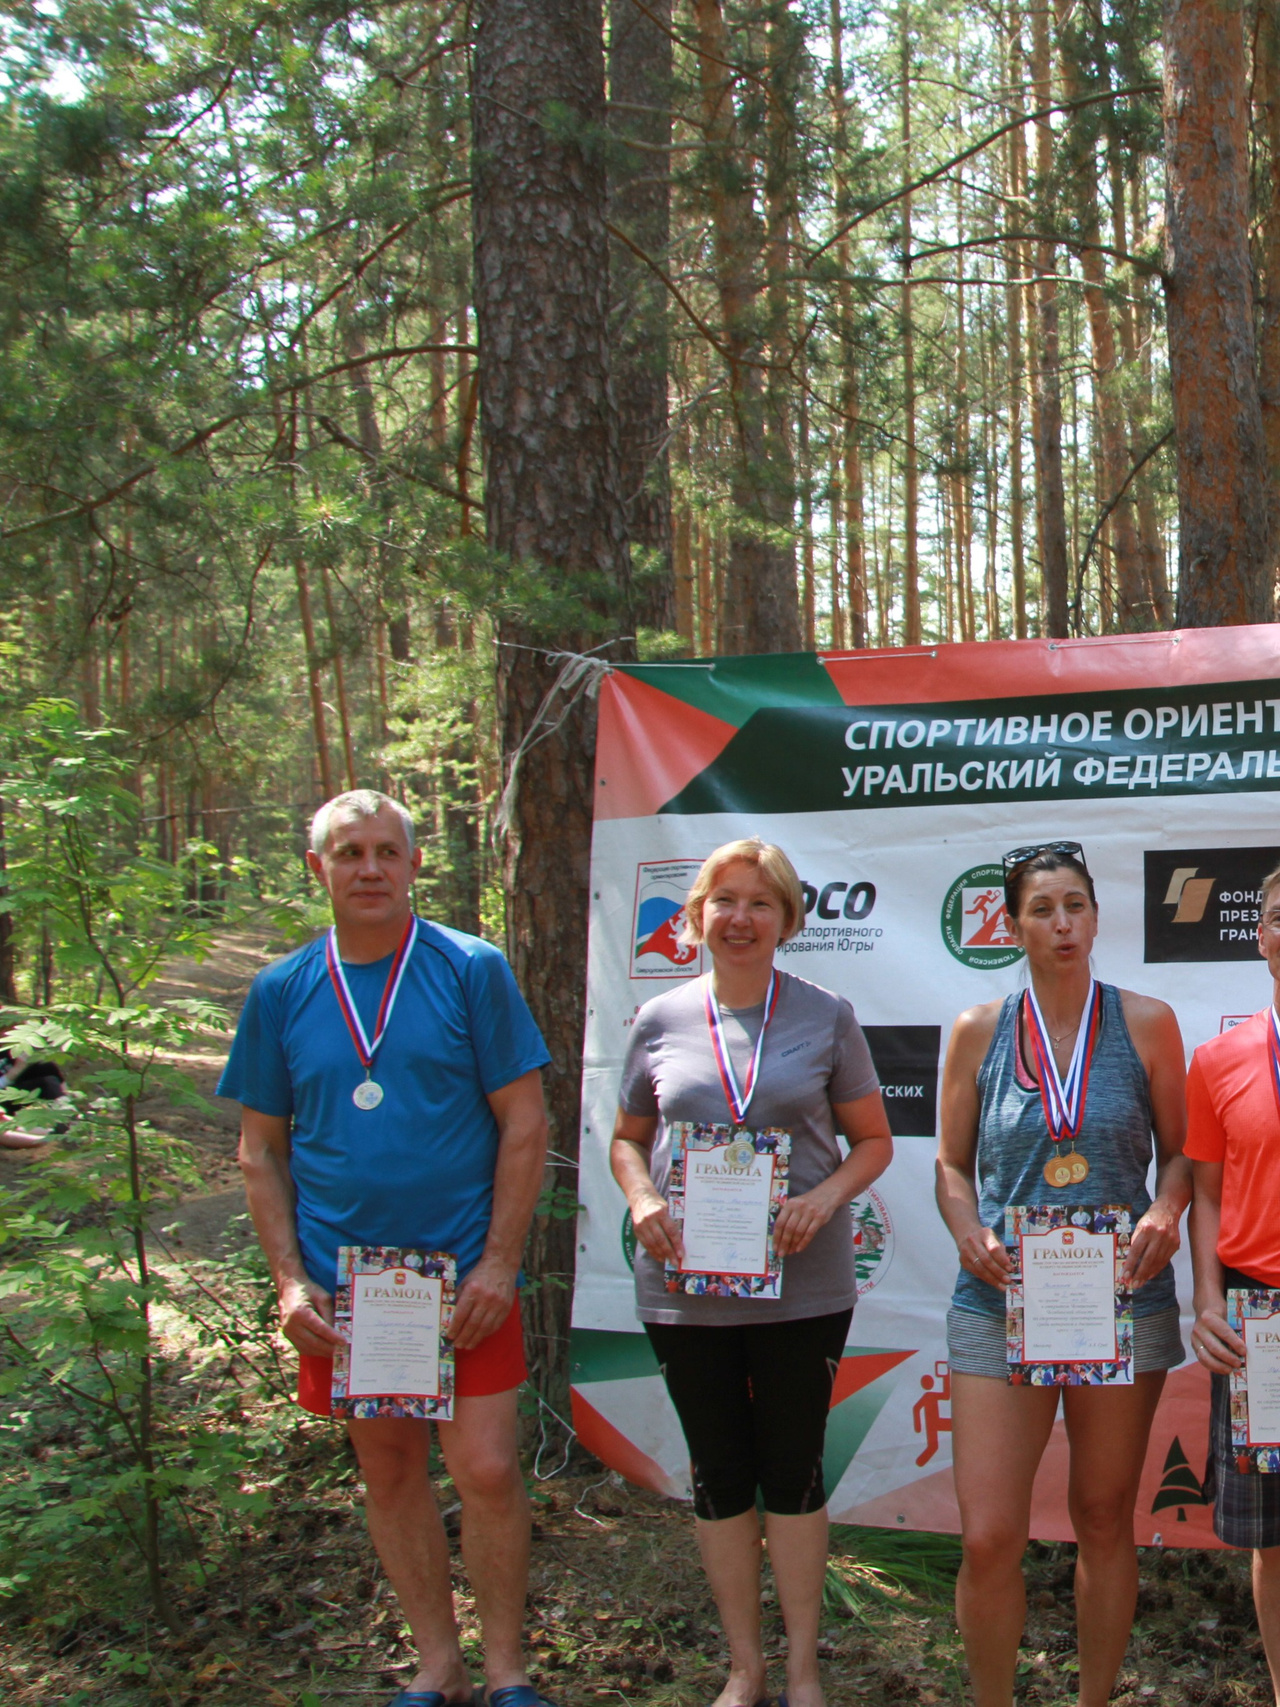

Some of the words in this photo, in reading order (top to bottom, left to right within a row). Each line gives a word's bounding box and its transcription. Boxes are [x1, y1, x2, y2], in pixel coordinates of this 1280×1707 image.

[844, 710, 1113, 751] СПОРТИВНОЕ
[841, 751, 1062, 797] УРАЛЬСКИЙ
[945, 878, 968, 920] ФЕДЕРАЦИЯ
[971, 868, 1008, 880] СПОРТИВ
[1219, 891, 1264, 905] ФОНД
[1220, 909, 1260, 923] ПРЕЗ
[945, 925, 964, 955] ОБЛАСТИ
[1220, 928, 1259, 941] ГРАН
[777, 941, 834, 956] ирования
[836, 938, 874, 954] Югры
[879, 1085, 924, 1098] ТСКИХ
[695, 1162, 762, 1177] ГРАМОТА
[1032, 1247, 1105, 1260] ГРАМОТА
[364, 1286, 433, 1301] ГРАМОТА
